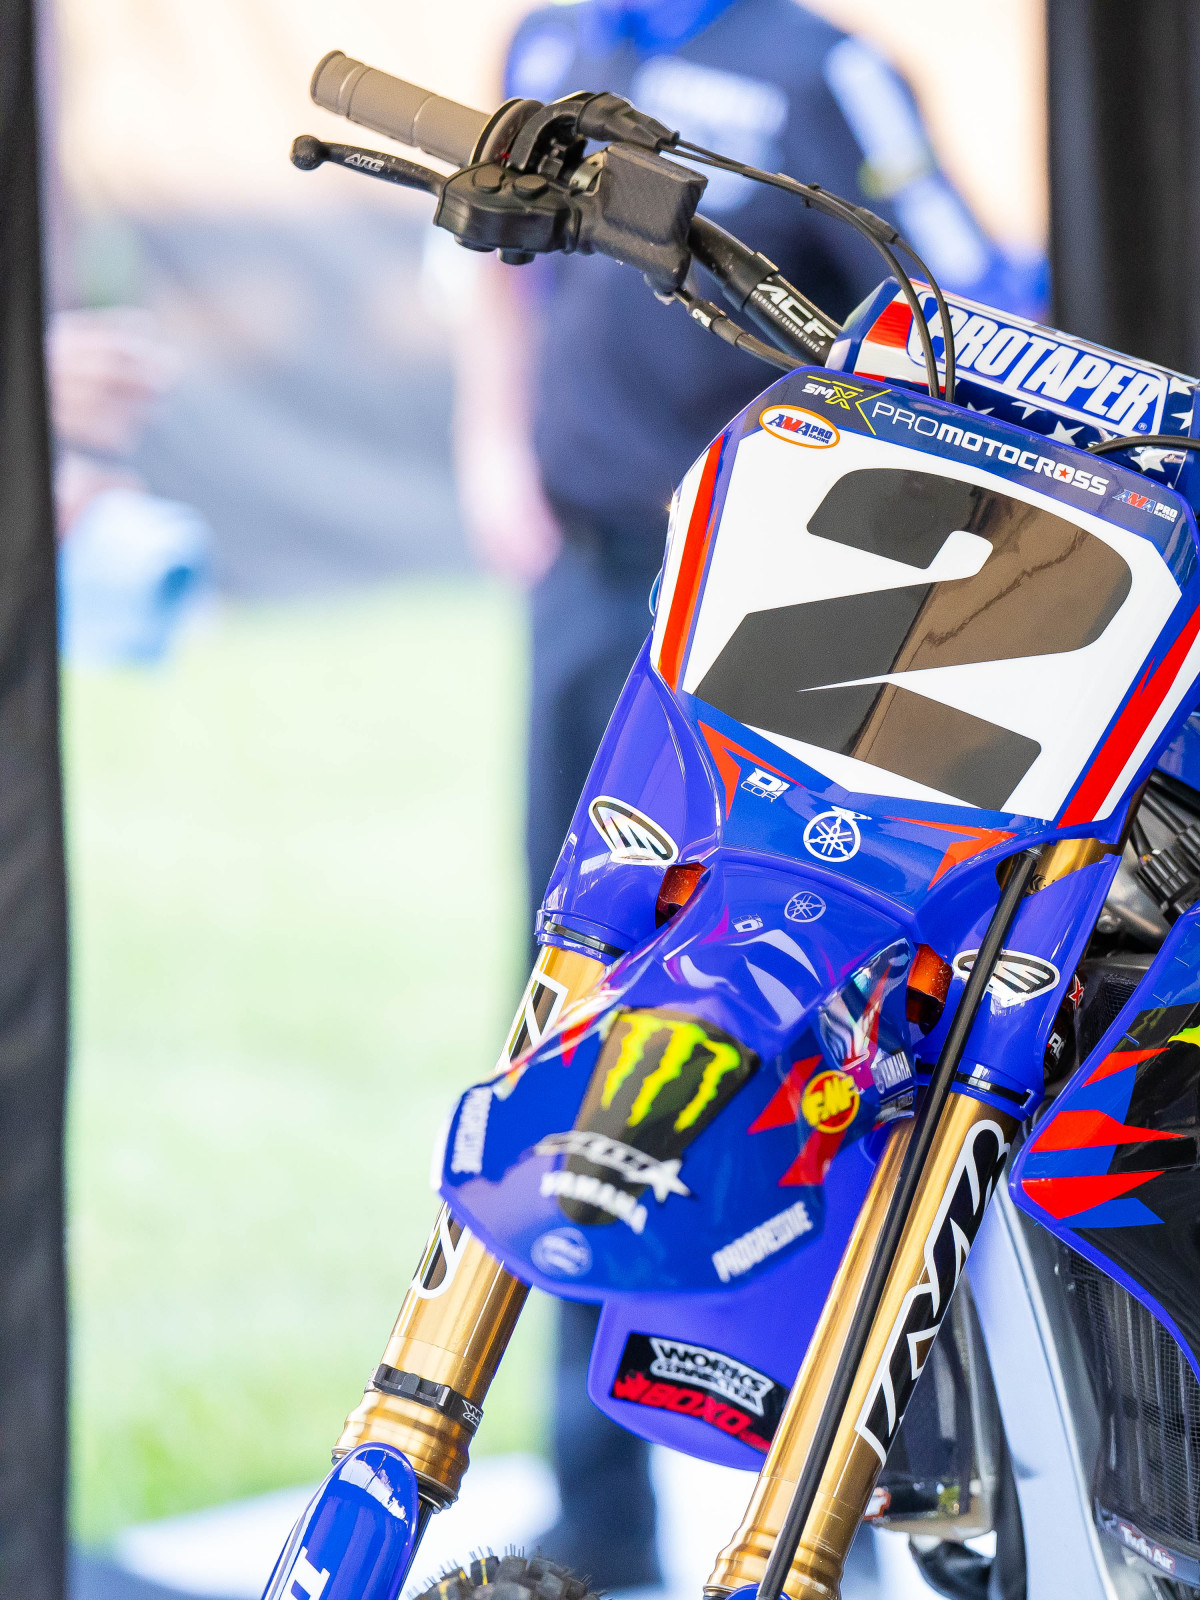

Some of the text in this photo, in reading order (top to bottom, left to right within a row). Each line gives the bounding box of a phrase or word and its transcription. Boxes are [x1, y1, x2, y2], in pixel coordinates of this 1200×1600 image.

[757, 283, 837, 339] ACF
[802, 383, 858, 410] SMX
[807, 434, 830, 445] RACING
[811, 425, 833, 441] PRO
[1155, 503, 1178, 519] PRO
[693, 467, 1132, 810] 2
[658, 1343, 767, 1392] WORKS
